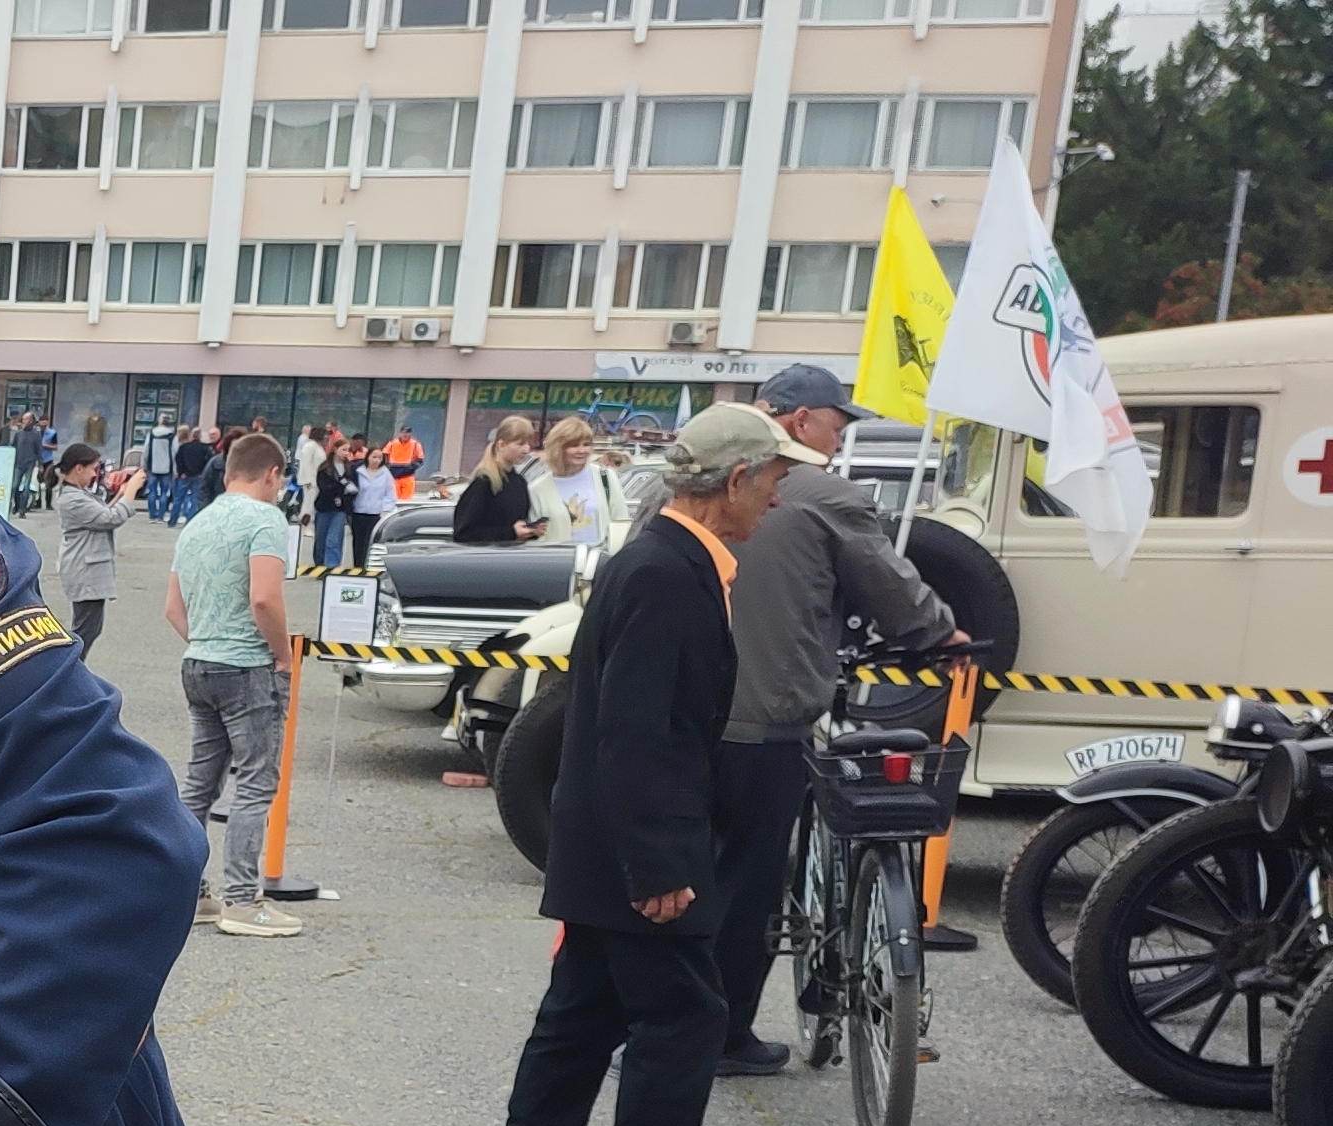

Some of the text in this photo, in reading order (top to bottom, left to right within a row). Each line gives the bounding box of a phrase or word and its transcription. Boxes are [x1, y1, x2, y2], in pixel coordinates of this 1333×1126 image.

[704, 361, 725, 374] 90
[728, 361, 758, 374] ЛЕТ
[1102, 736, 1178, 763] 220674
